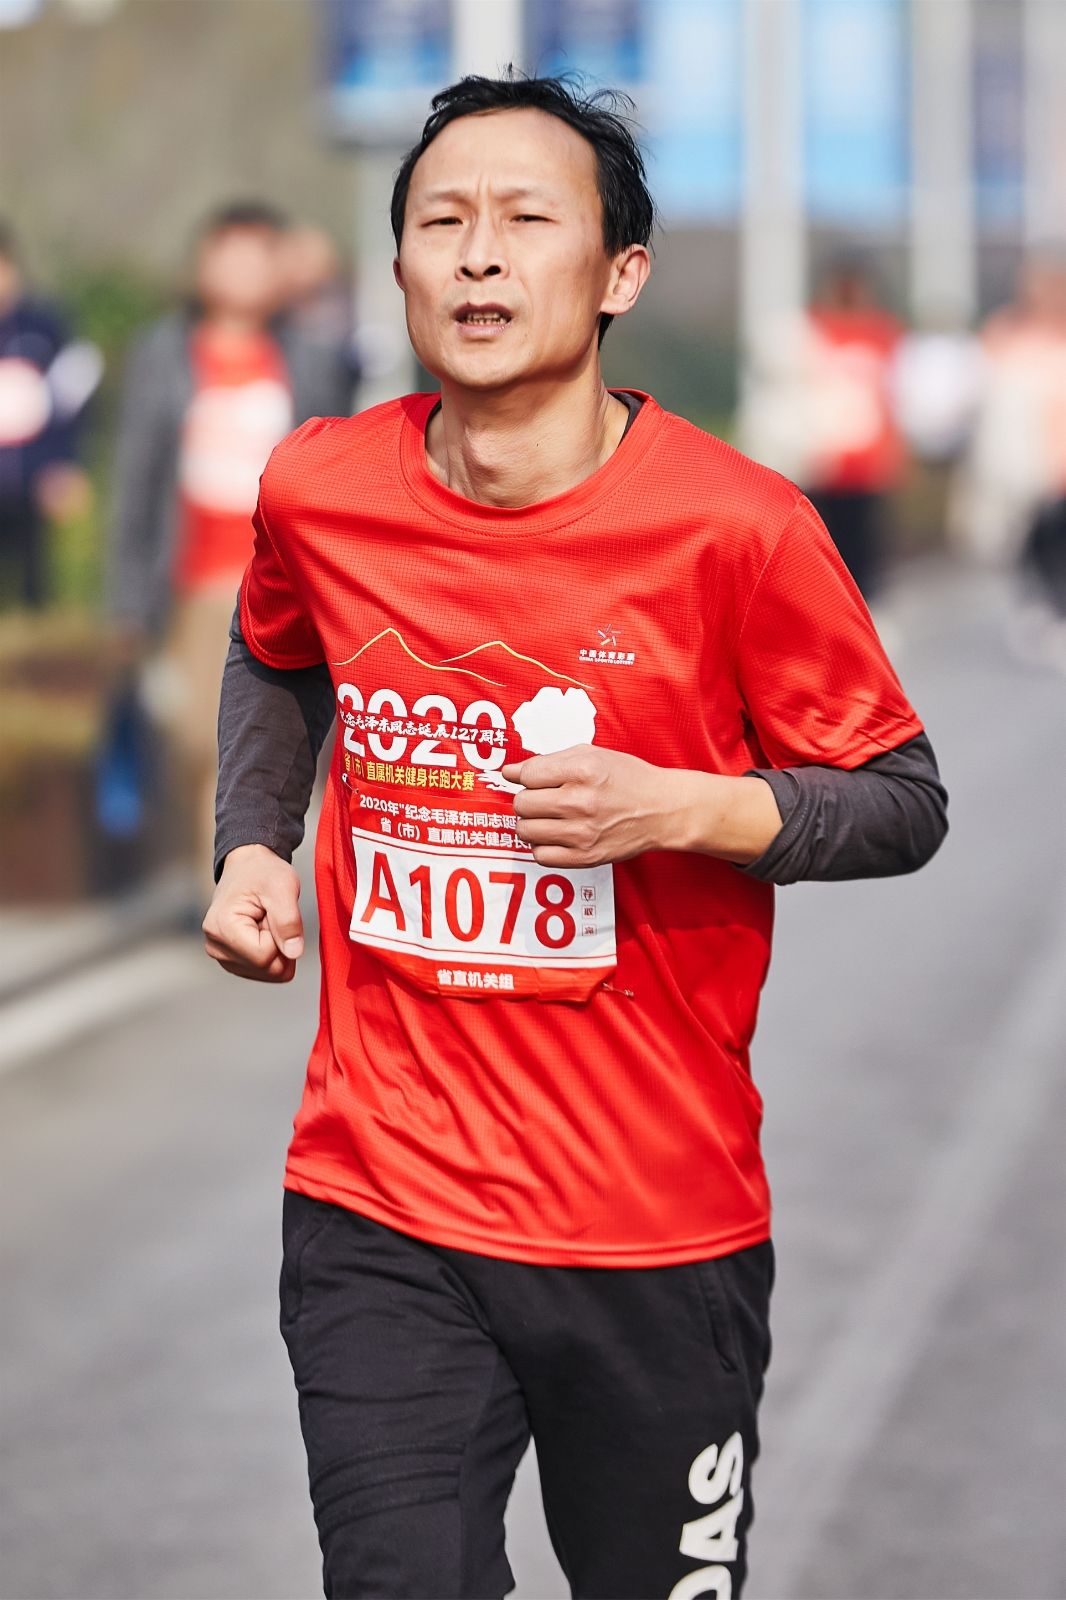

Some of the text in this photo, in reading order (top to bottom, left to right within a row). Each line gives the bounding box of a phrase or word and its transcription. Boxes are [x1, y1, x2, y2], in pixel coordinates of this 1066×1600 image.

[337, 683, 506, 770] 2020
[359, 794, 522, 829] 2020年"纪念毛泽东同志诞
[380, 817, 532, 849] 省（市）直属机关健身长
[360, 851, 577, 949] A1078
[436, 968, 515, 990] 省直机关组
